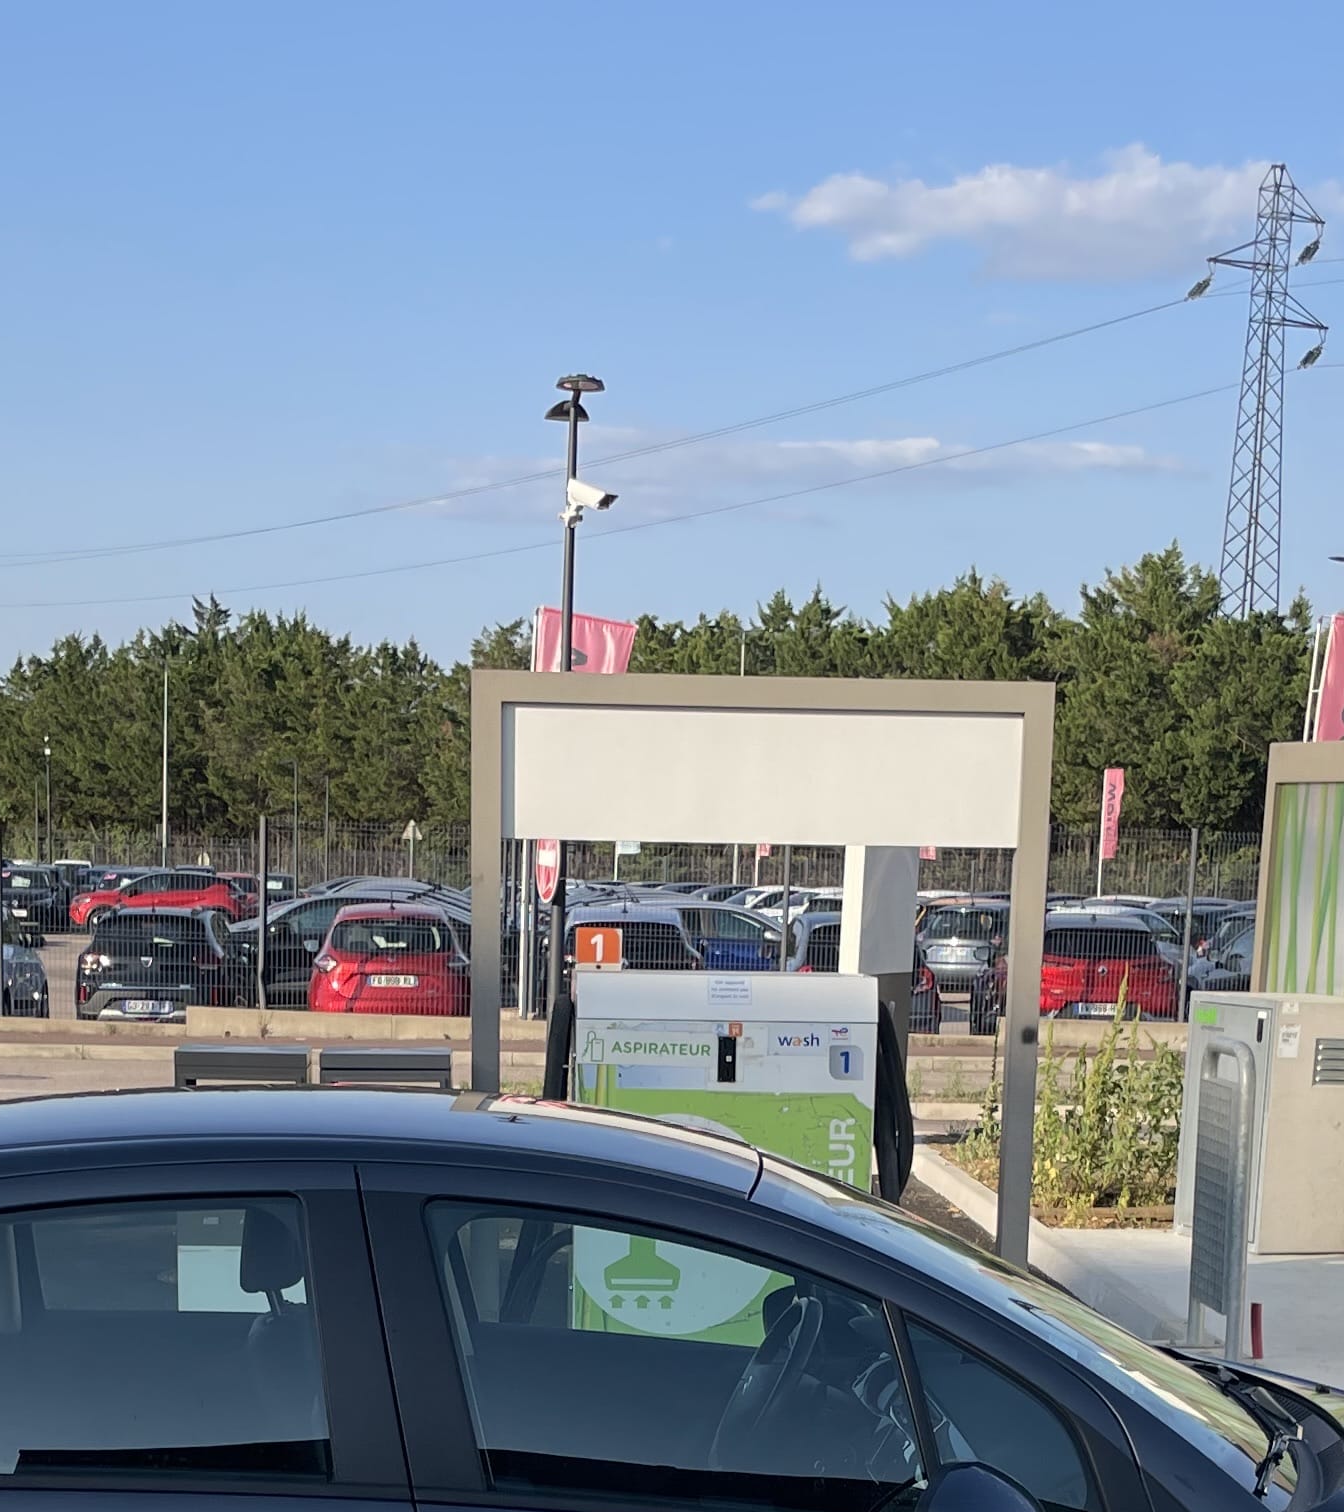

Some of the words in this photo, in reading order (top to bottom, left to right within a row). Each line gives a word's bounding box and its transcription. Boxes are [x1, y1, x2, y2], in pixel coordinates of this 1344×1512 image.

[590, 934, 604, 962] 1
[611, 1041, 711, 1057] ASPIRATEUR
[778, 1033, 820, 1047] wash
[840, 1051, 850, 1074] 1
